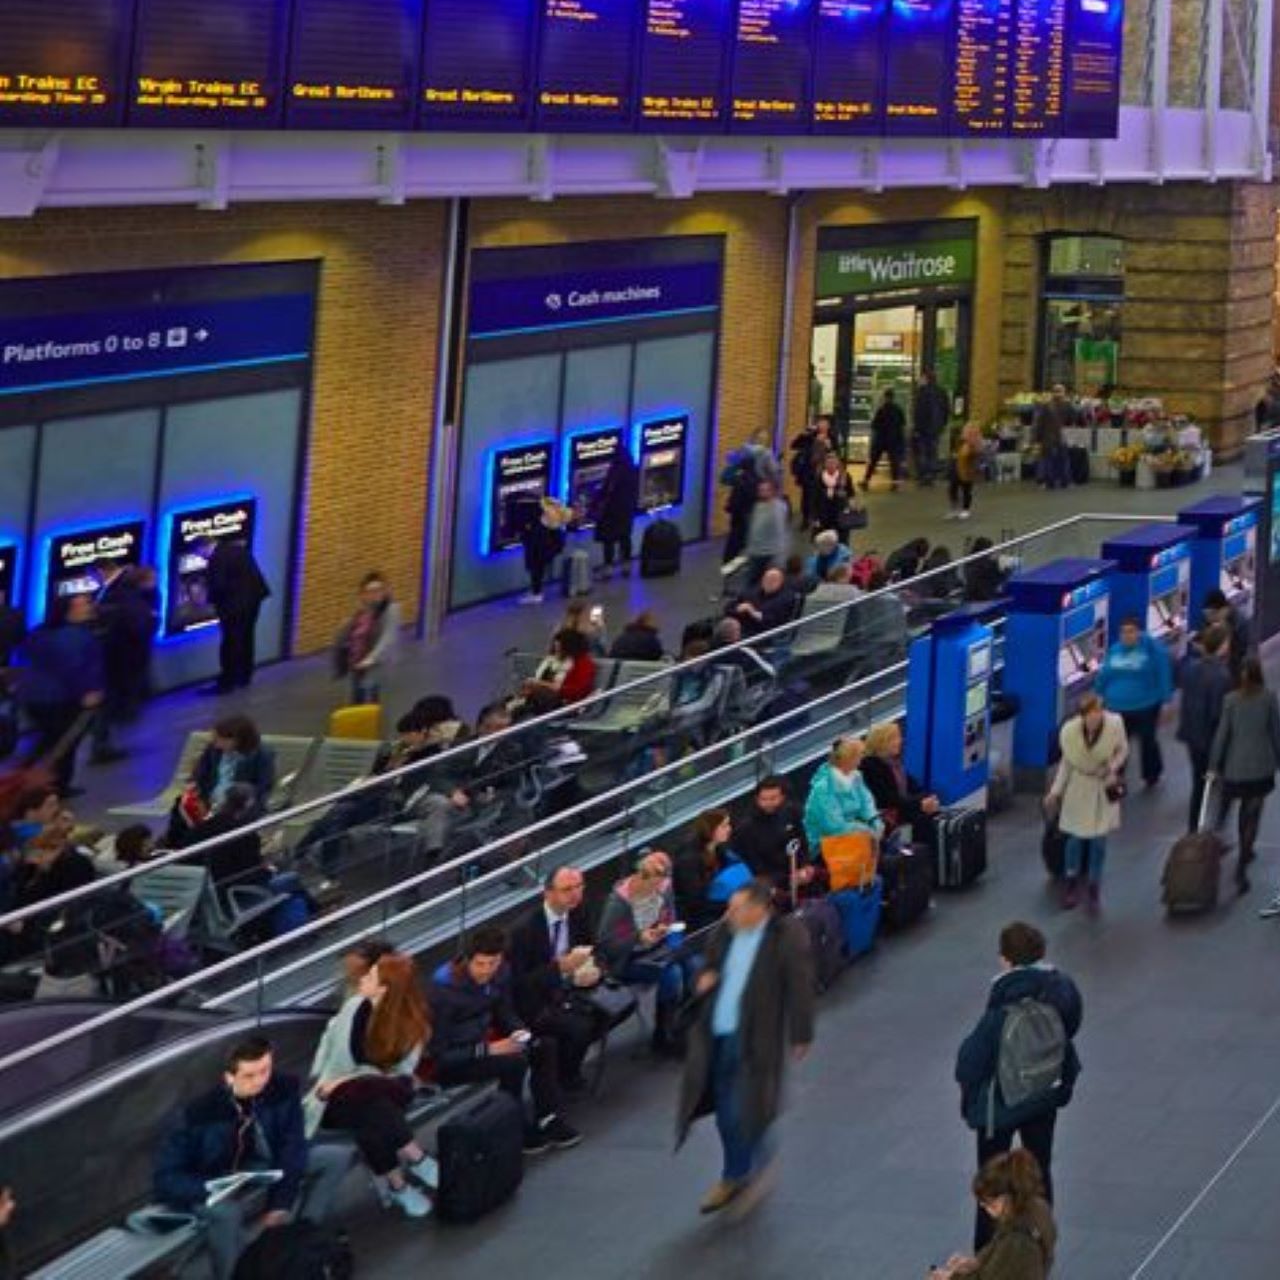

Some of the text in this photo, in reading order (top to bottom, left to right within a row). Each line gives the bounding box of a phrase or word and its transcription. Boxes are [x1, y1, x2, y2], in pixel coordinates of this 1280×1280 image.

[17, 74, 99, 91] Trains EC
[188, 79, 235, 96] Trains
[239, 80, 261, 96] EC
[868, 250, 957, 283] Waitrose
[568, 284, 661, 308] Cash machines
[3, 331, 162, 364] Platforms 0 to 8
[181, 517, 212, 537] Free
[213, 509, 248, 527] Cash
[60, 541, 95, 560] Free
[97, 531, 134, 550] Cash
